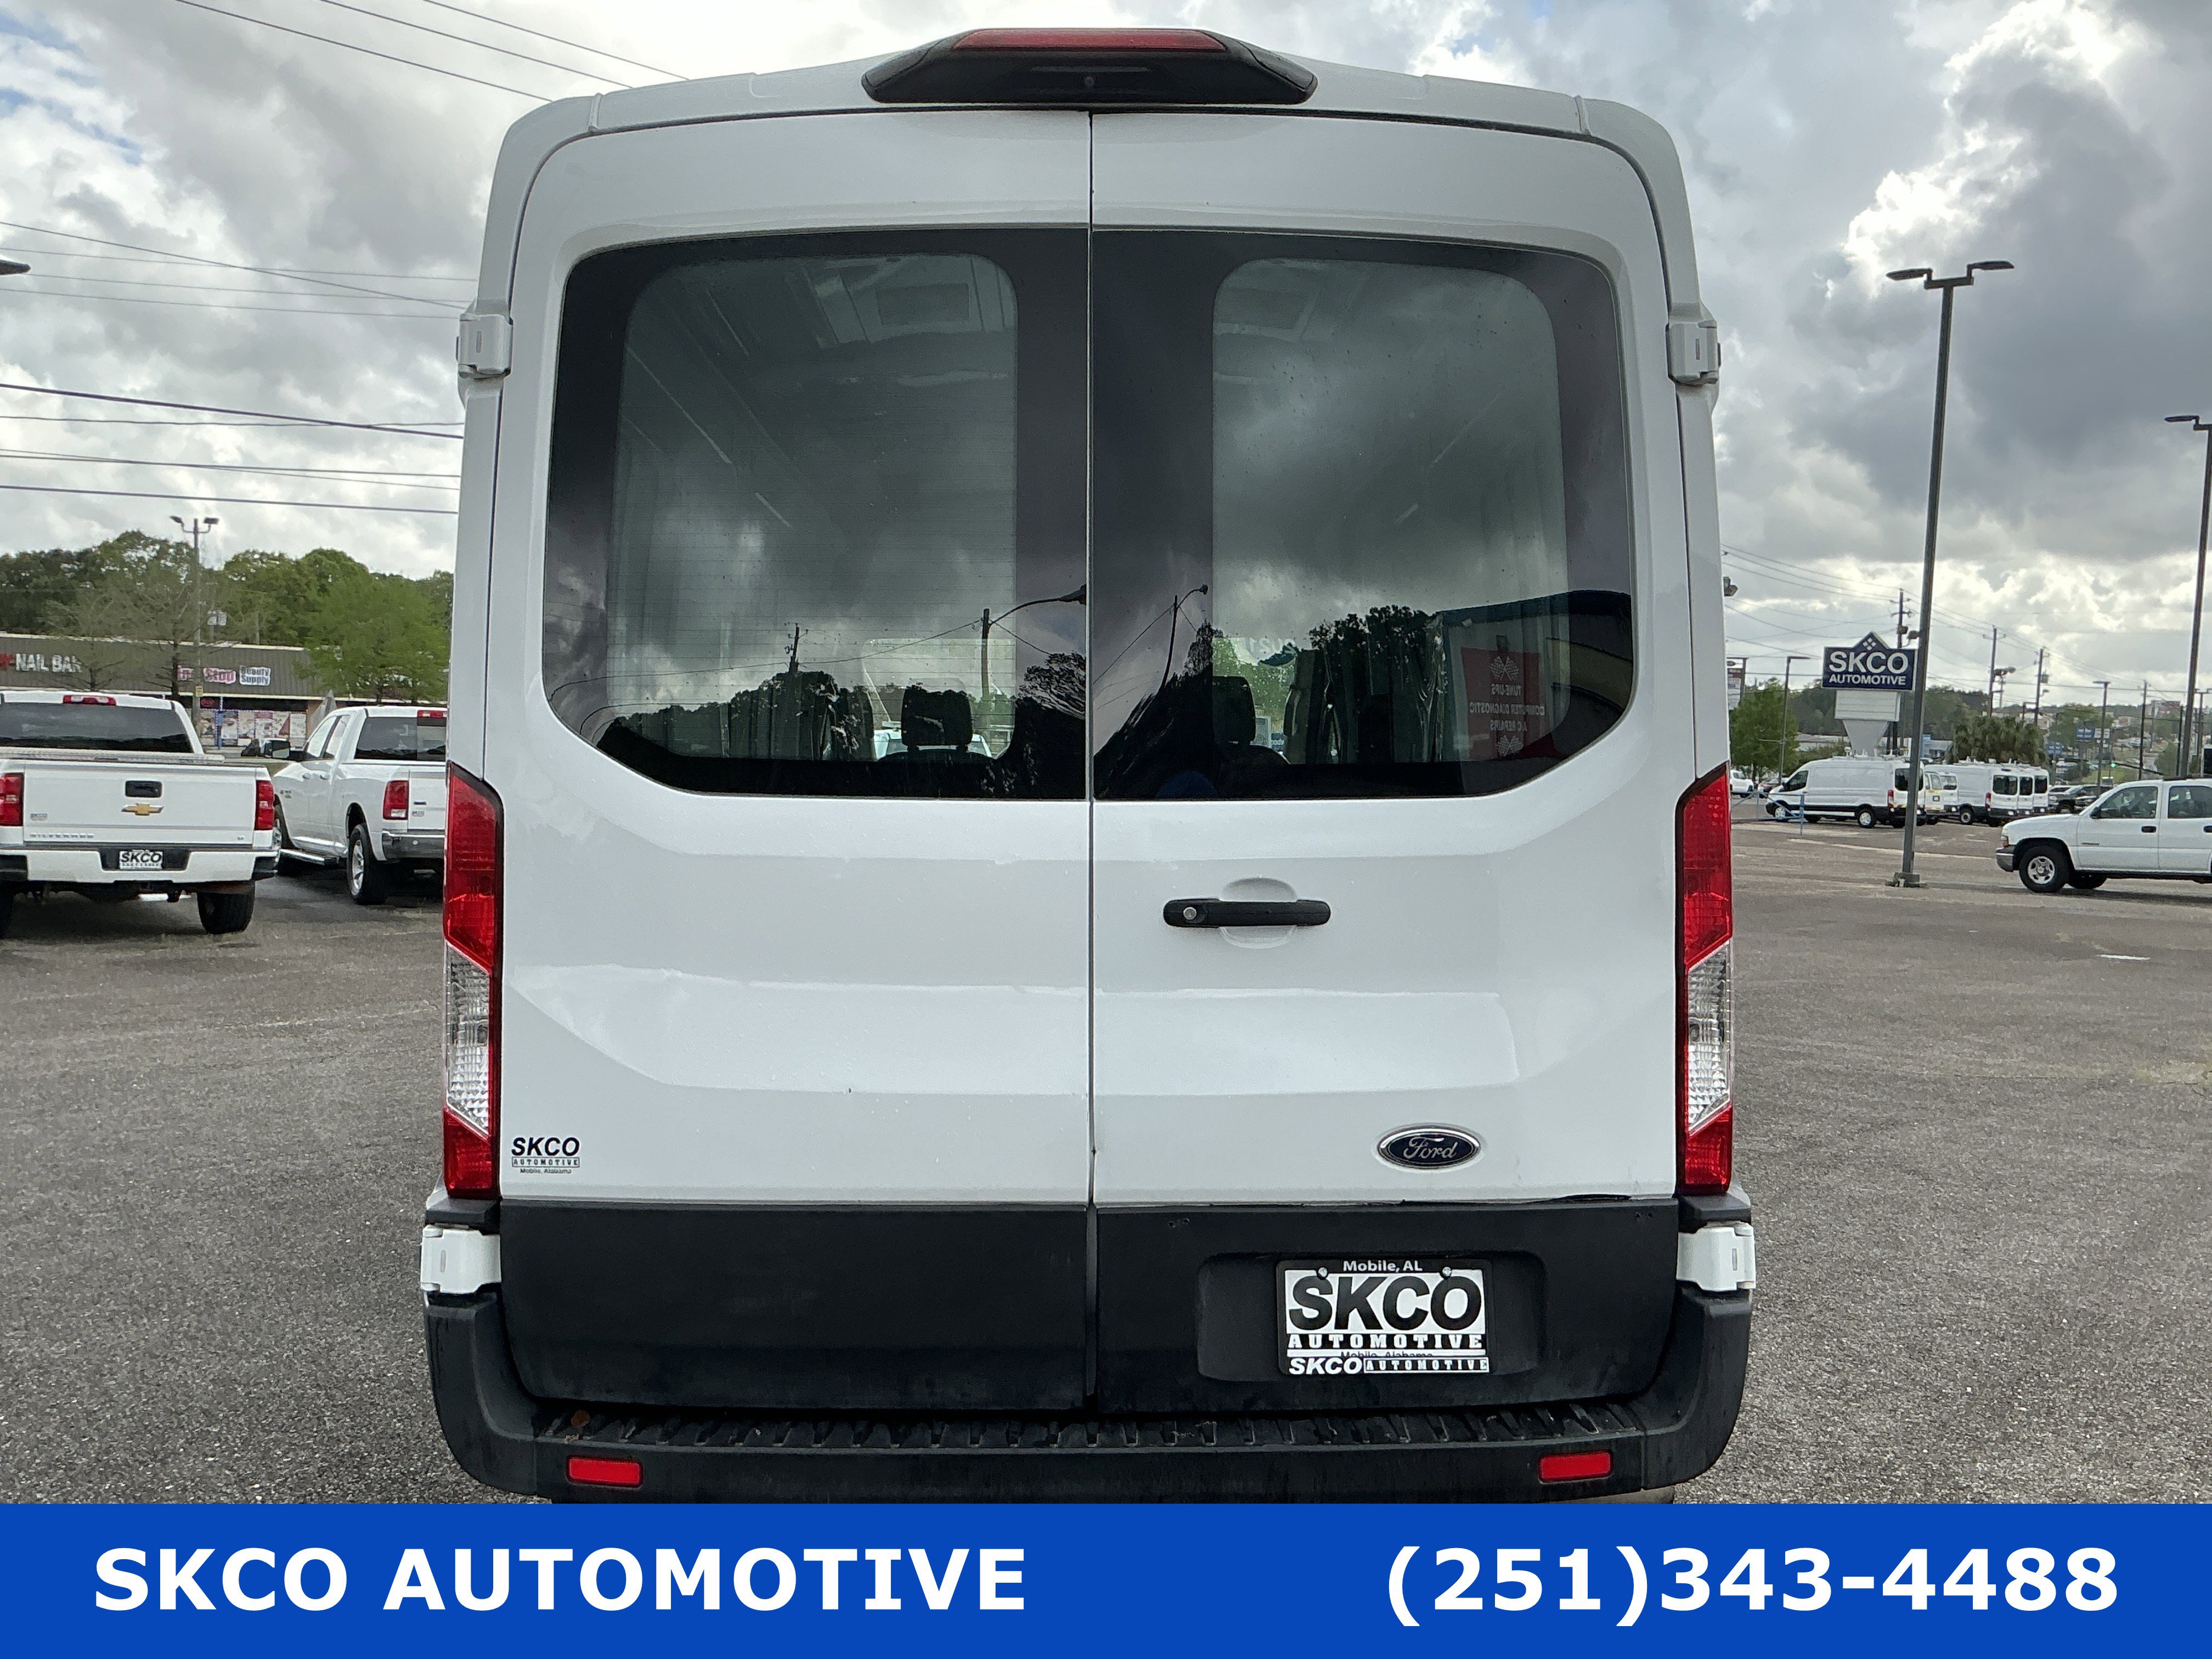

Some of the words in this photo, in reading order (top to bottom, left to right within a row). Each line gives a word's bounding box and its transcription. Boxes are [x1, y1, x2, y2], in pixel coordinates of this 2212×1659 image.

[15, 653, 49, 672] NAIL
[1829, 651, 1909, 674] SKCO
[241, 667, 269, 676] Beauty
[241, 675, 269, 685] Supply
[1829, 674, 1906, 686] AUTOMOTIVE
[121, 853, 162, 863] SKCO
[511, 1137, 580, 1156] SKCO
[1403, 1136, 1458, 1159] Ford
[1343, 1260, 1400, 1273] Mobile,
[1402, 1261, 1423, 1272] AL
[1289, 1275, 1482, 1331] SKCO
[1288, 1333, 1482, 1349] AUTOMOTIVE
[1289, 1357, 1363, 1375] SKCO
[1367, 1359, 1487, 1371] AUTOMOTIVE
